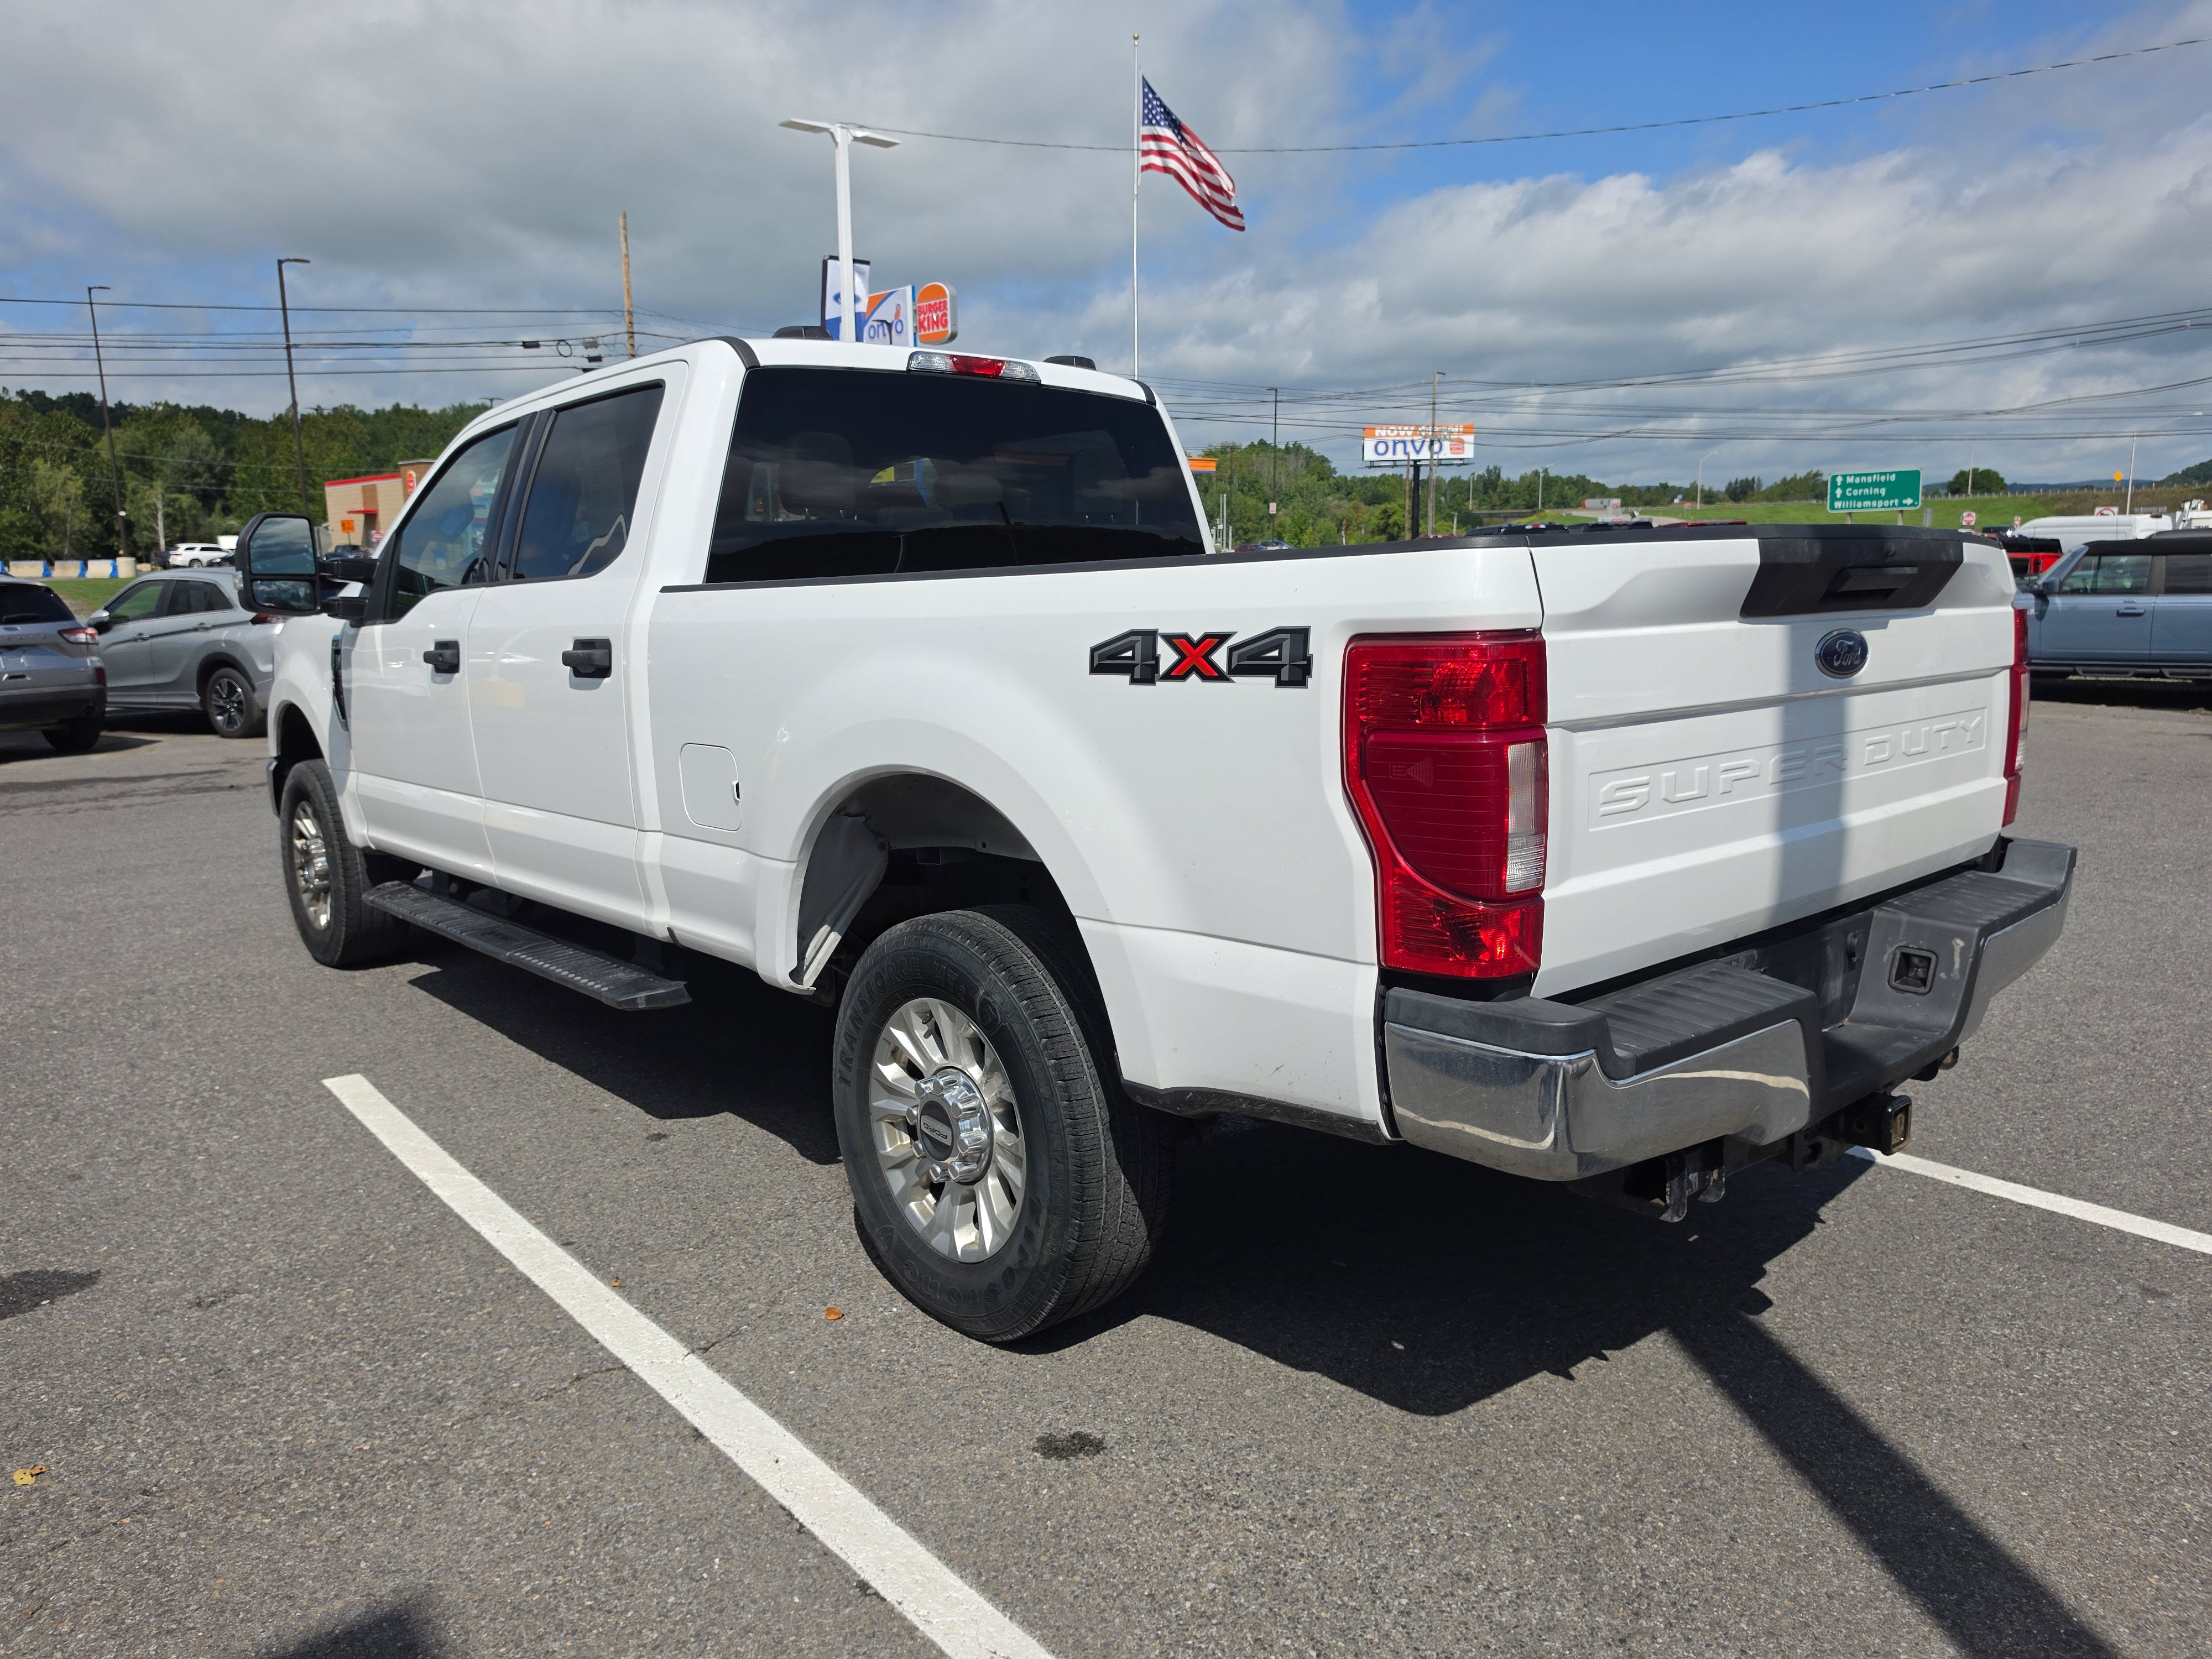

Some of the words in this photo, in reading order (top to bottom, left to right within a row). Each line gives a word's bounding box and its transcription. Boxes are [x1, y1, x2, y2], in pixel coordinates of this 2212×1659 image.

[917, 300, 947, 316] BURGER
[919, 313, 948, 333] KING
[1375, 426, 1414, 436] NOW
[1374, 439, 1443, 456] onvo
[1846, 473, 1896, 484] Mansfield
[1845, 487, 1886, 497] Corning
[1834, 498, 1899, 509] Williamsport
[1833, 639, 1861, 667] Ford
[1599, 741, 1847, 817] SUPER
[1864, 716, 1981, 766] DUTY
[838, 957, 922, 1088] TRANSFORCE
[923, 1122, 948, 1140] FORD
